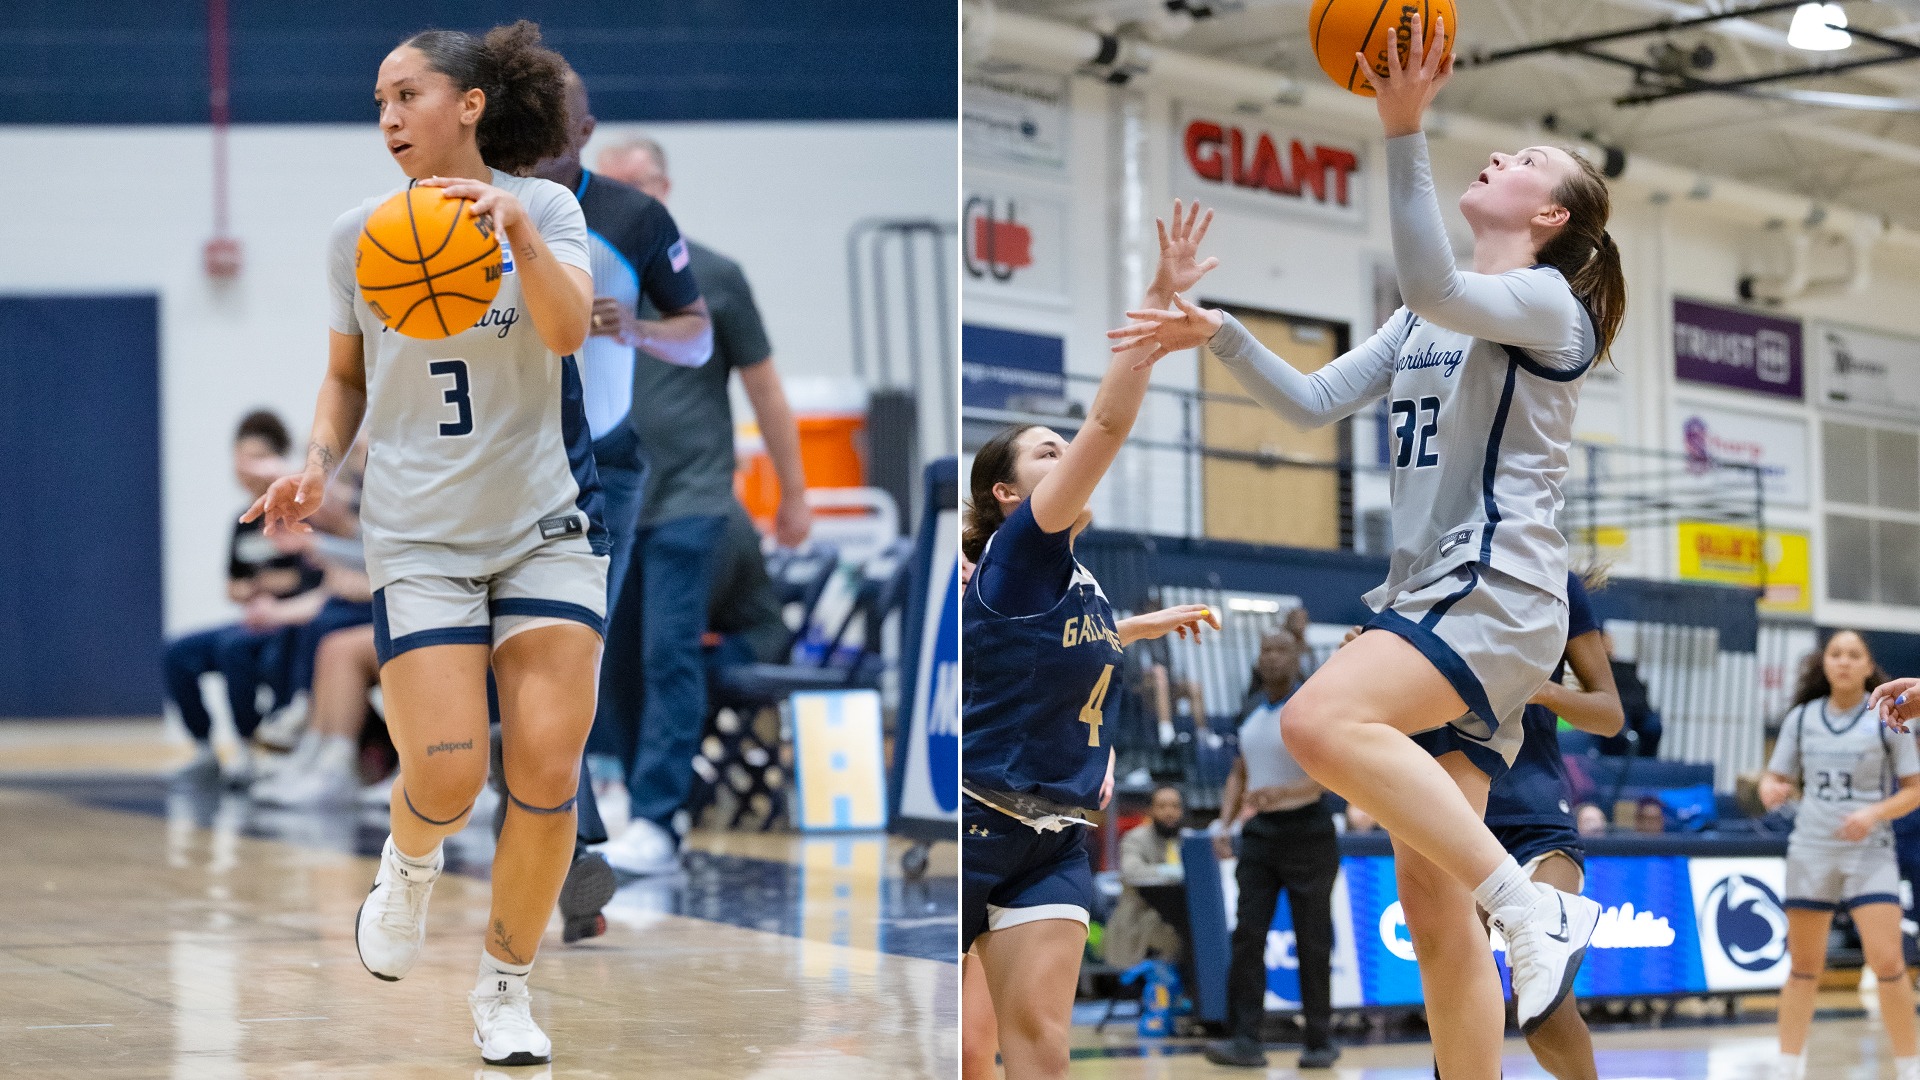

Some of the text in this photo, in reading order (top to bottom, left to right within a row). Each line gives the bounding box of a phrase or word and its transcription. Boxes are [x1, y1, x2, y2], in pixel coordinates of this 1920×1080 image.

[1184, 119, 1357, 207] GIANT
[1676, 322, 1755, 370] TRUIST
[428, 359, 473, 436] 3
[1391, 396, 1440, 468] 32
[1078, 664, 1115, 747] 4
[427, 738, 473, 757] godspeed
[1817, 770, 1852, 801] 23
